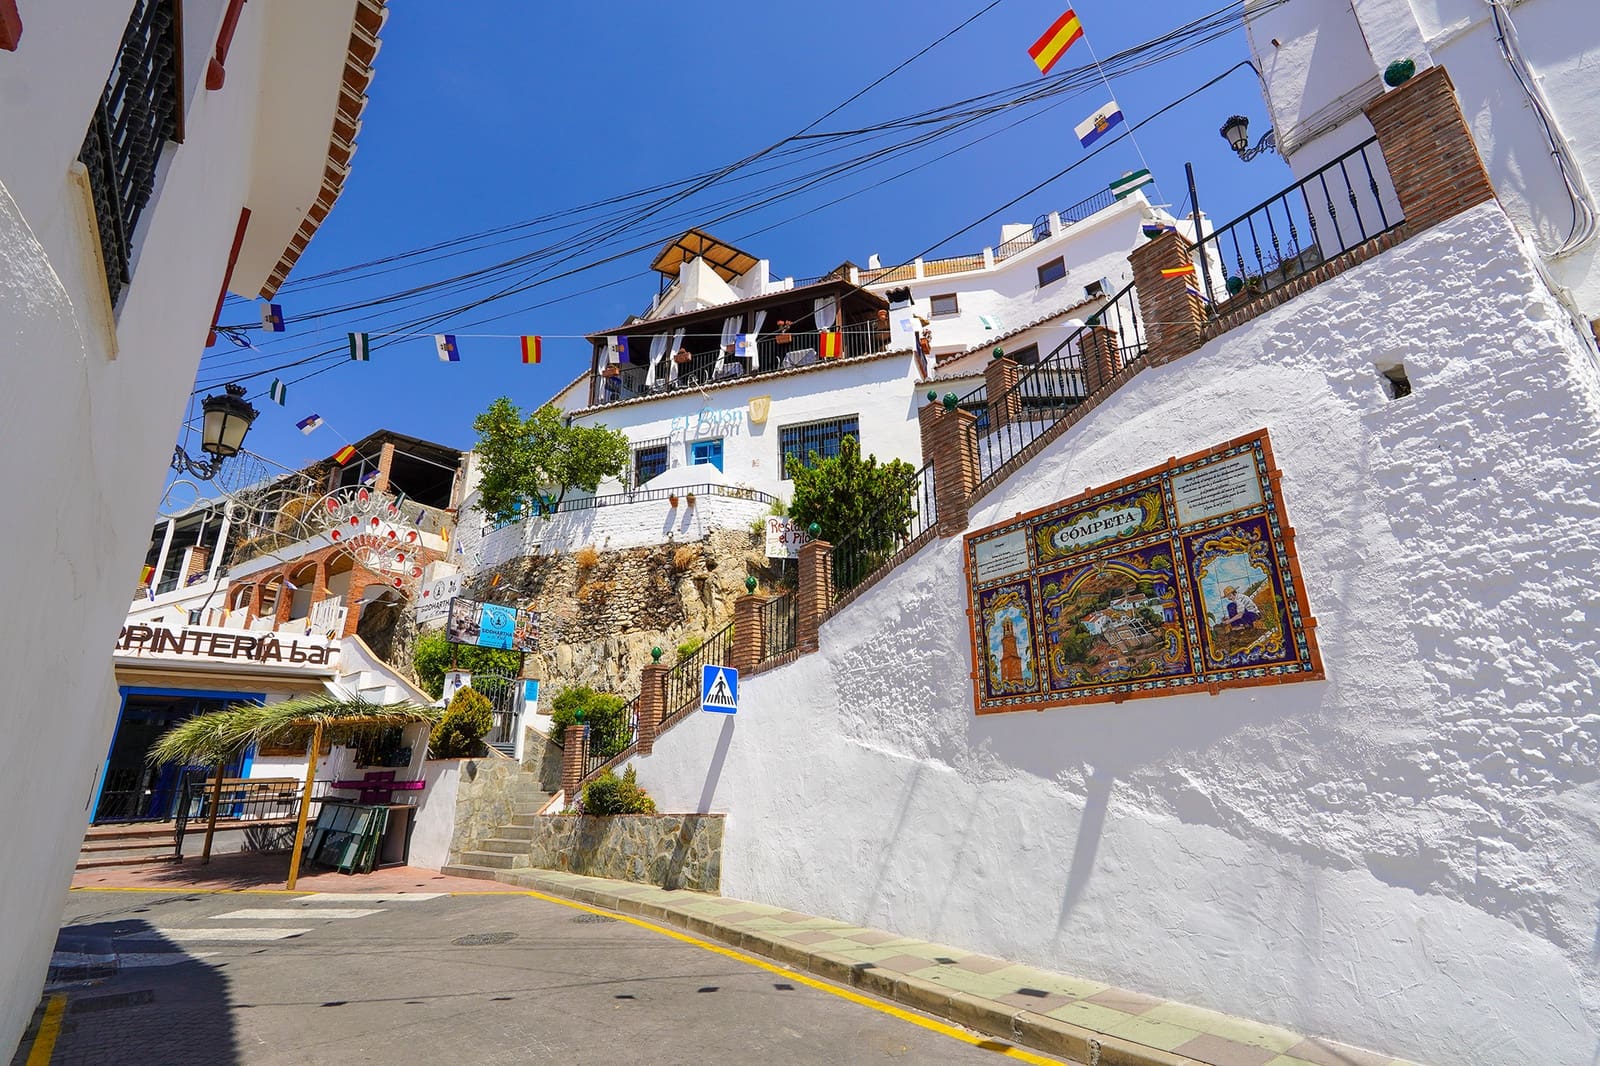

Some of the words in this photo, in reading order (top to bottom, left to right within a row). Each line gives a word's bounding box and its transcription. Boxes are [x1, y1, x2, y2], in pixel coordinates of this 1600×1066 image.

[779, 533, 789, 544] el
[1060, 512, 1136, 542] CÓMPETA
[289, 640, 341, 665] bar
